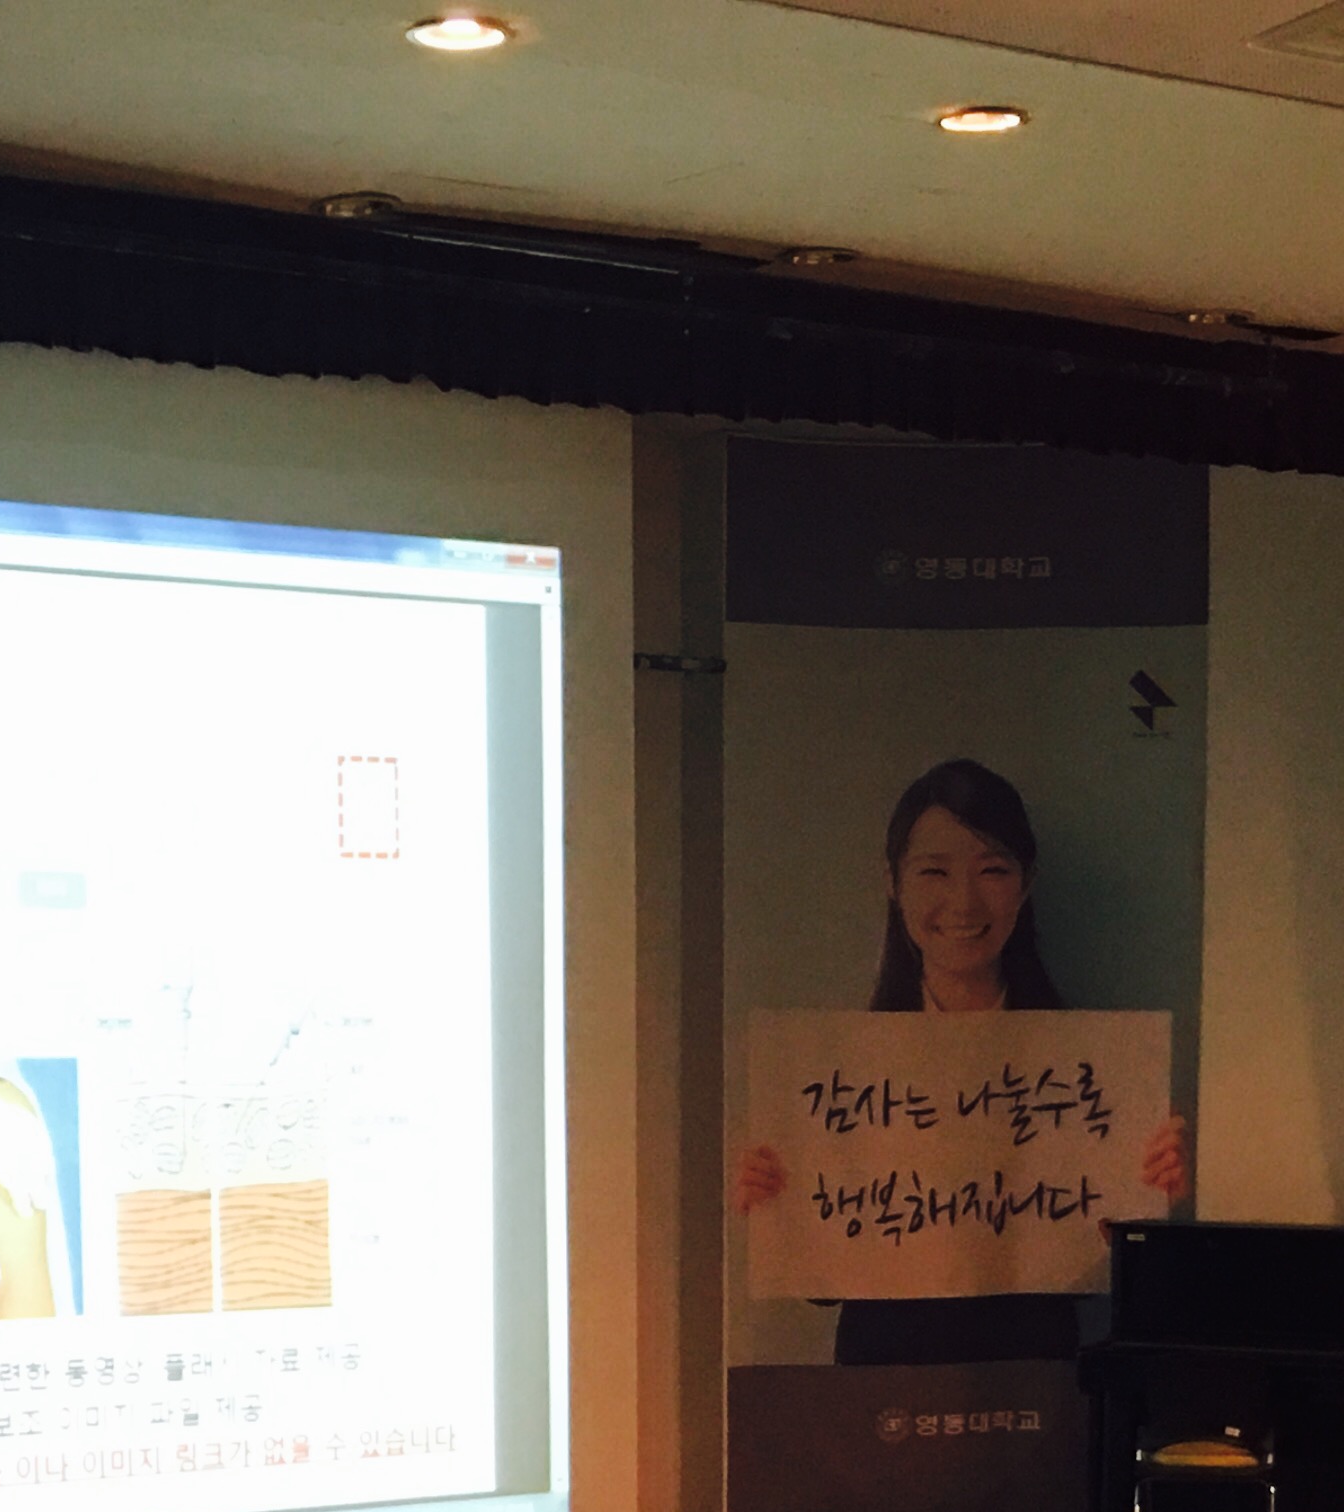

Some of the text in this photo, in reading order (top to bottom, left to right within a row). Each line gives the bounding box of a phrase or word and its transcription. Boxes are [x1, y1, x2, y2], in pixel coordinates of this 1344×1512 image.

[914, 555, 1053, 581] 영동대학교
[802, 1062, 1114, 1147] 감사는 나눌수록
[811, 1170, 1102, 1247] 행복해집니다
[63, 1354, 144, 1390] 동영상
[916, 1409, 1041, 1437] 영동대학교
[16, 1450, 69, 1484] 이나
[82, 1445, 162, 1479] 이미지
[175, 1438, 252, 1473] 링크가
[263, 1434, 312, 1466] 없을
[325, 1432, 347, 1461] 수
[358, 1422, 458, 1460] 있습니다
